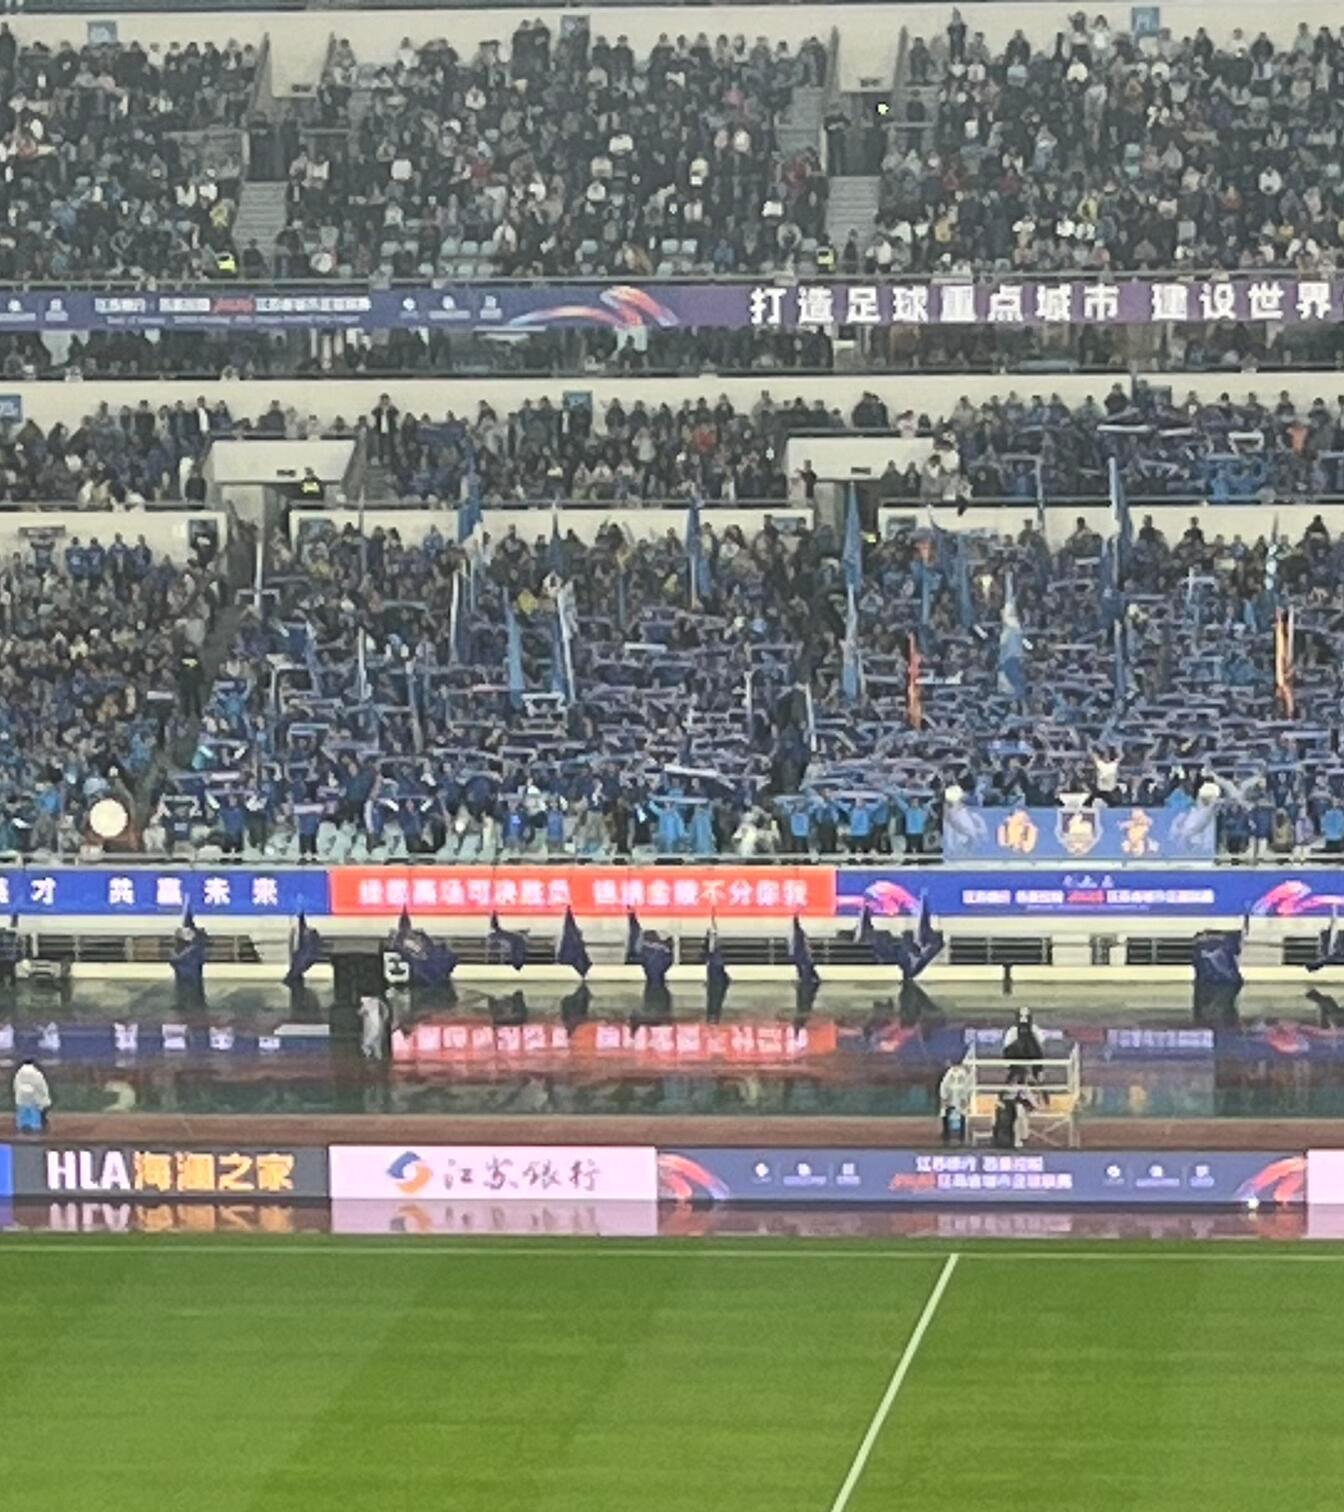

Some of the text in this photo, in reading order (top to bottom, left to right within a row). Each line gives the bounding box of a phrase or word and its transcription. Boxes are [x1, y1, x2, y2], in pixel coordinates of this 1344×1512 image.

[749, 284, 1120, 324] 打造足球重点城市
[45, 1150, 131, 1190] HLA
[133, 1152, 296, 1191] 海澜之家
[444, 1156, 601, 1193] 江苏银行
